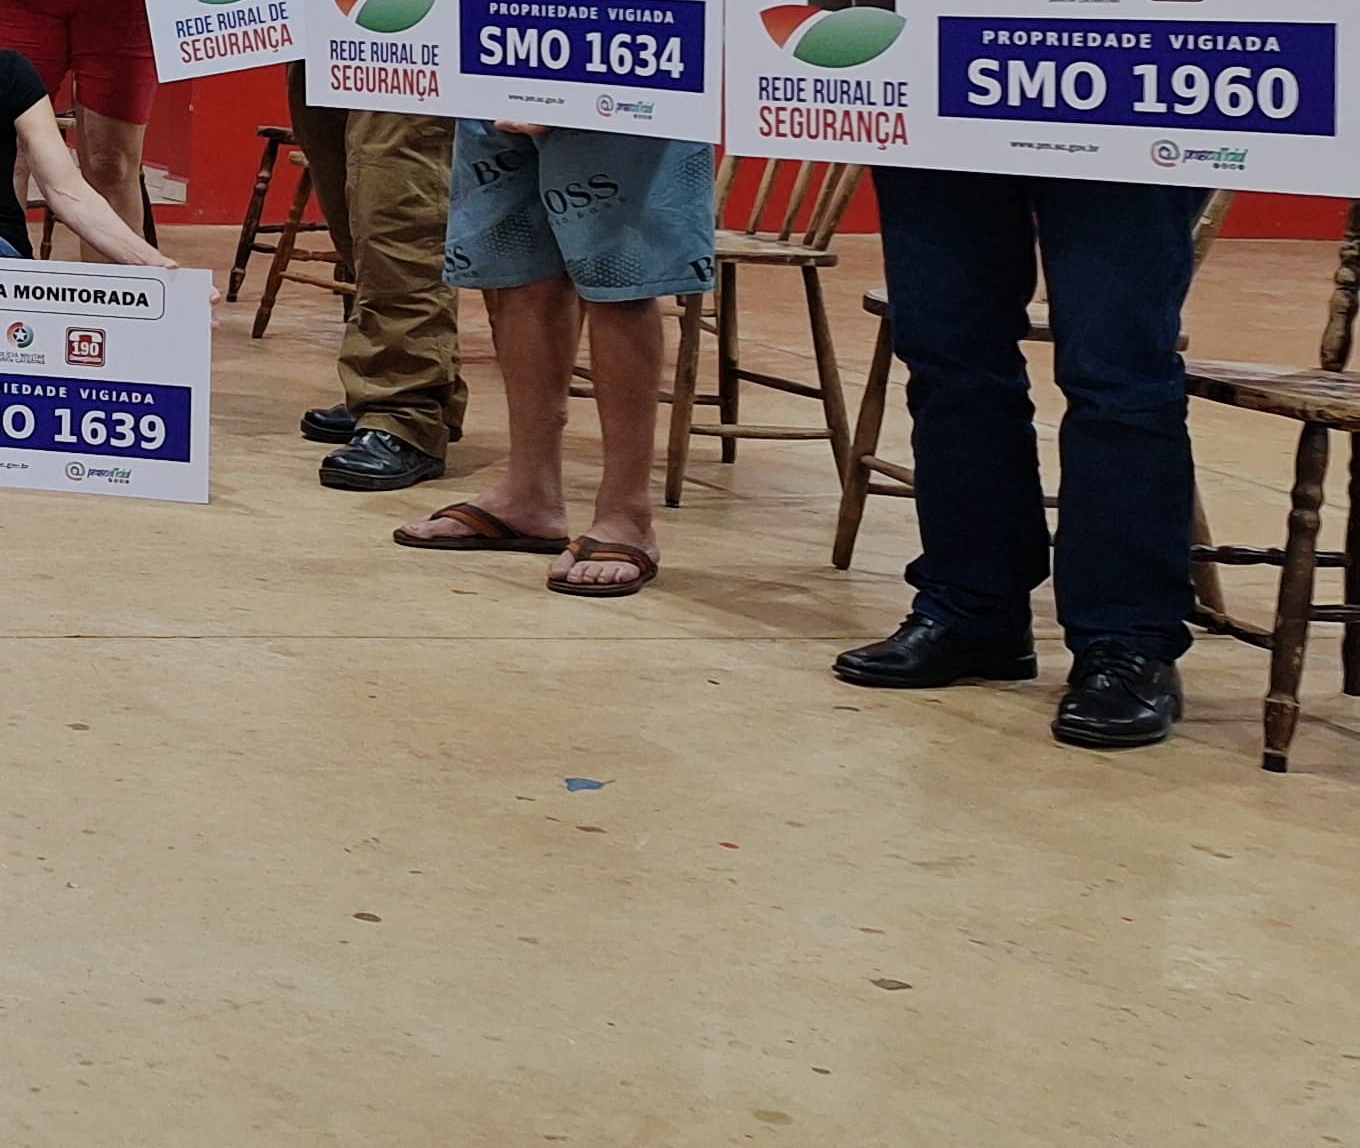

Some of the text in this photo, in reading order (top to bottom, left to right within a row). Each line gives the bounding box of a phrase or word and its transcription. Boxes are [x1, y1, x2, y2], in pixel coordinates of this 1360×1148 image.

[176, 2, 288, 38] REDE RURAL DE
[490, 3, 674, 23] PROPRIEDADE VIGIADA
[180, 25, 292, 63] SEGURANÇA
[330, 40, 439, 66] REDE RURAL DE
[480, 26, 684, 78] SMO 1634
[983, 31, 1280, 51] PROPRIEDADE VIGIADA
[331, 65, 439, 101] SEGURANÇA
[759, 77, 908, 107] REDE RURAL DE
[968, 59, 1298, 118] SMO 1960
[760, 106, 908, 150] SEGURANÇA
[14, 285, 148, 307] MONITORADA
[72, 341, 98, 356] 190
[80, 389, 153, 404] VIGIADA
[55, 409, 165, 449] 1639
